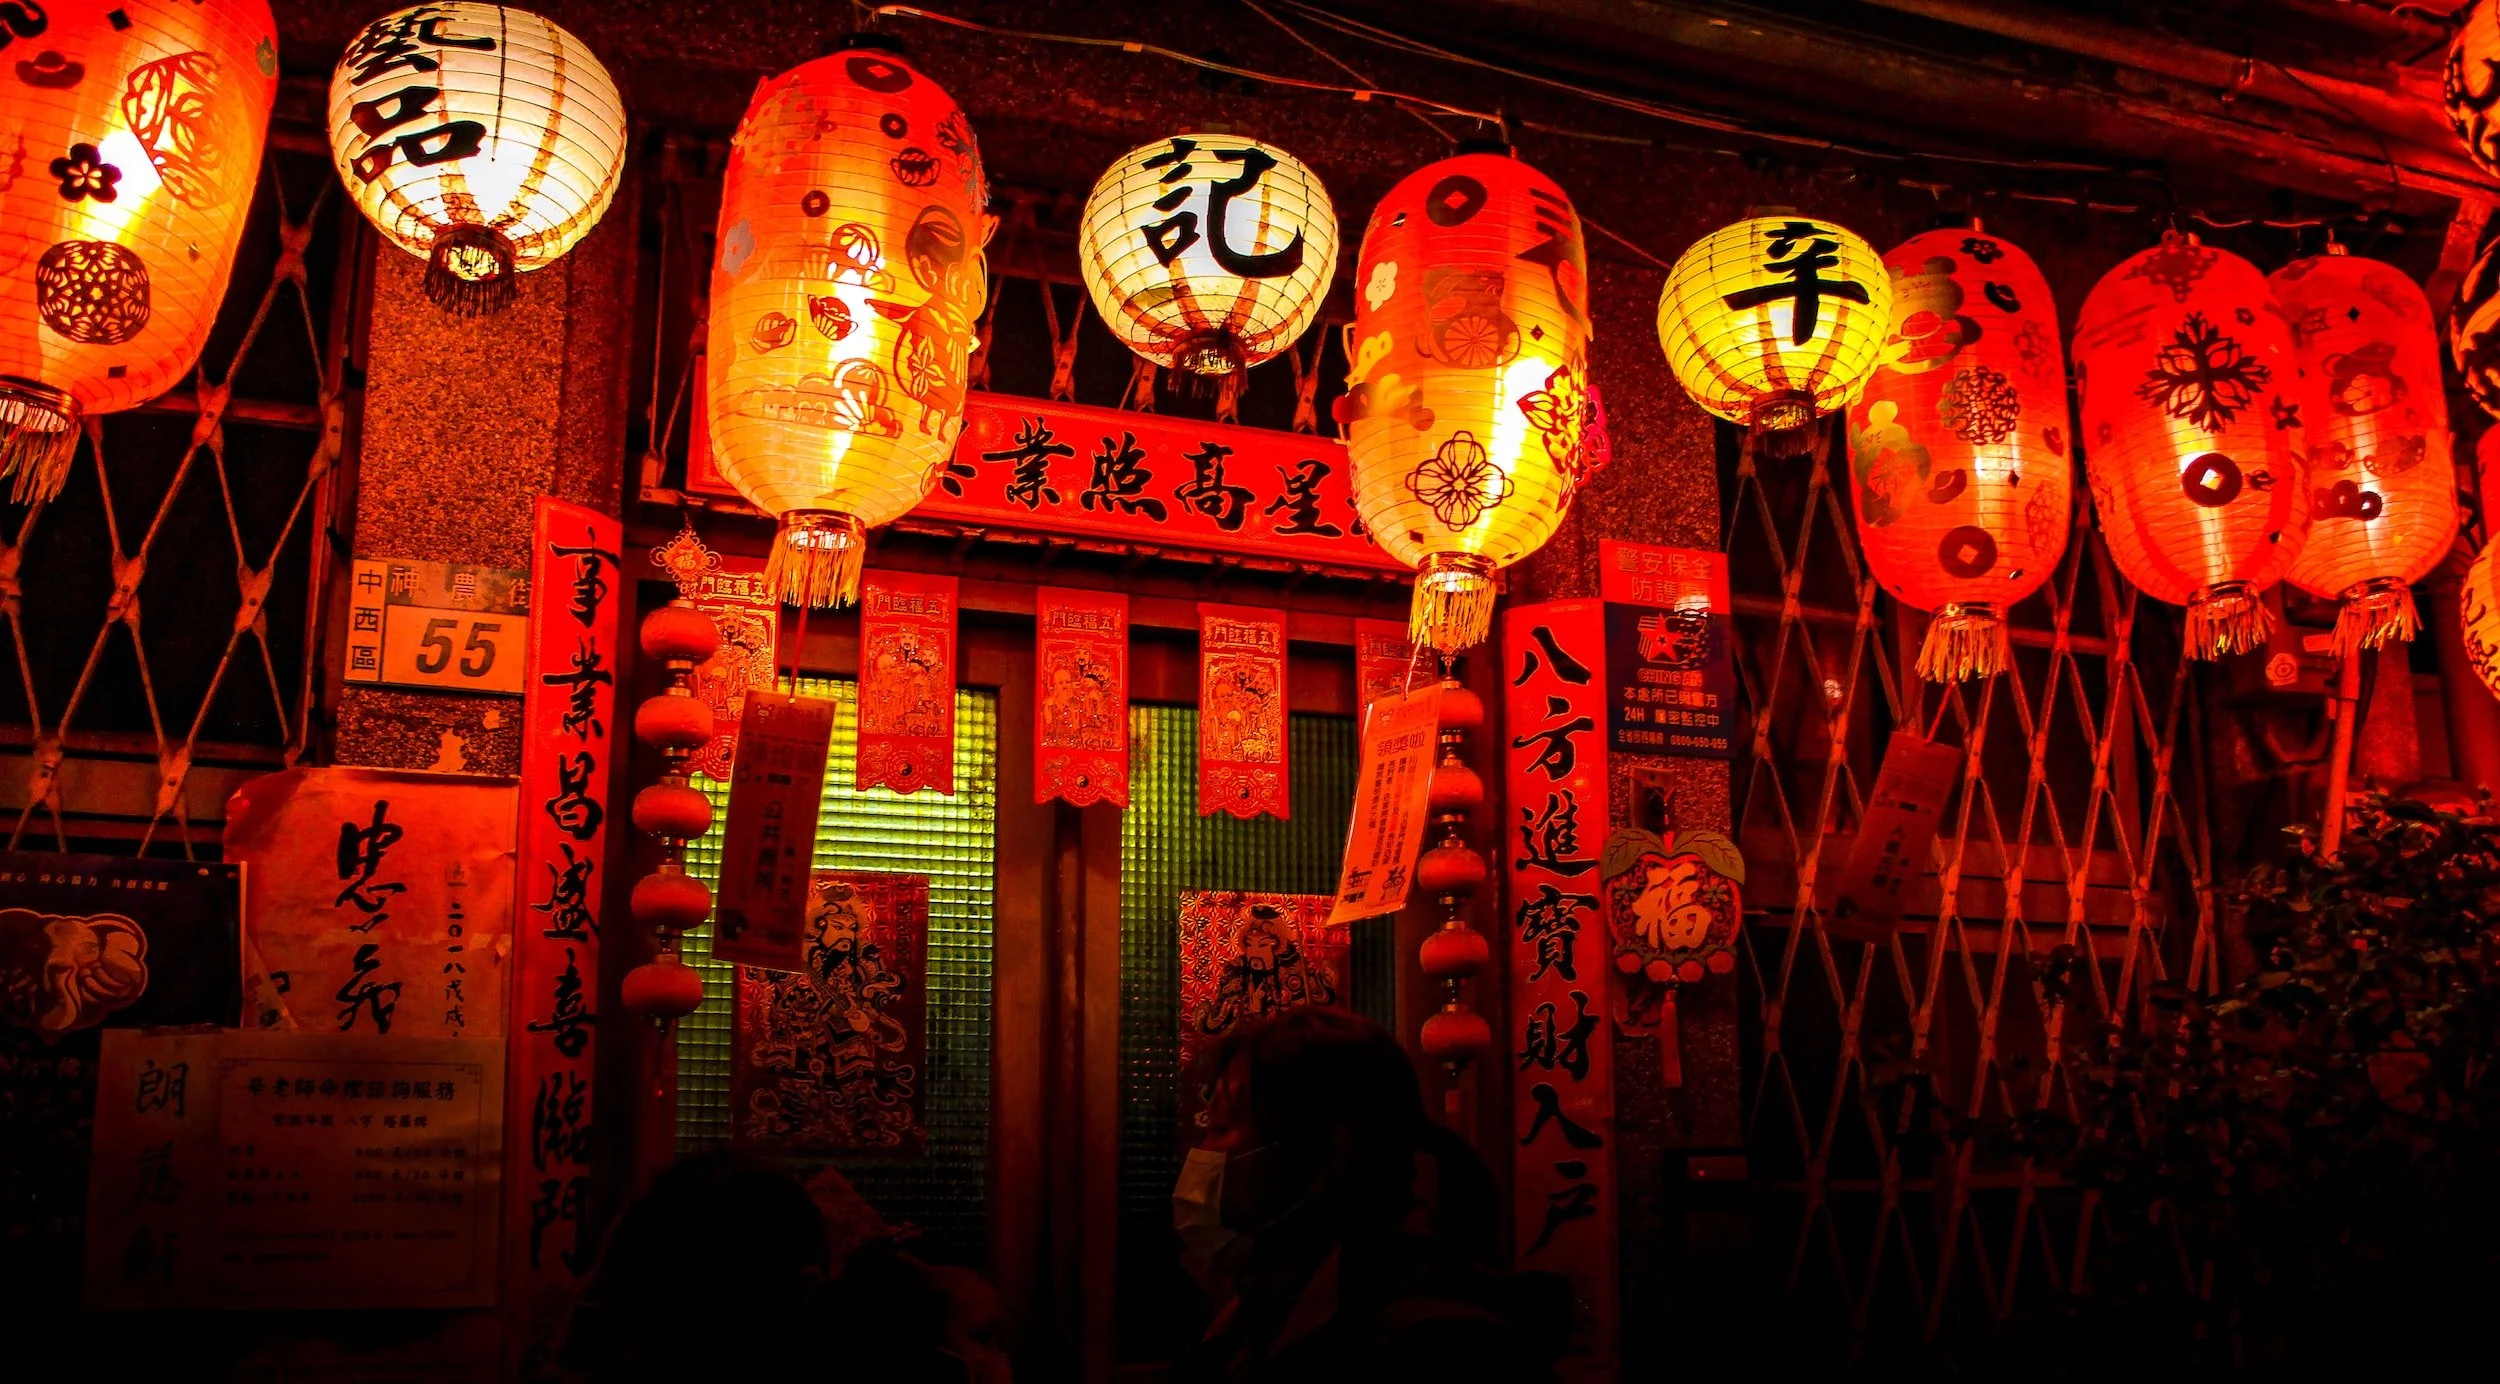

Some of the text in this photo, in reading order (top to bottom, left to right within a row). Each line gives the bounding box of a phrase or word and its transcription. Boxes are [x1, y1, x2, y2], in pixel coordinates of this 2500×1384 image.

[1141, 138, 1304, 279] 記
[1722, 221, 1870, 347] 辛
[390, 566, 531, 609] 神農街
[1616, 547, 1713, 581] 警安保全
[351, 569, 382, 672] 中西區
[416, 617, 502, 678] 55
[1637, 668, 1681, 686] CHING
[1623, 706, 1646, 723] 24H
[1633, 861, 1712, 952] 福
